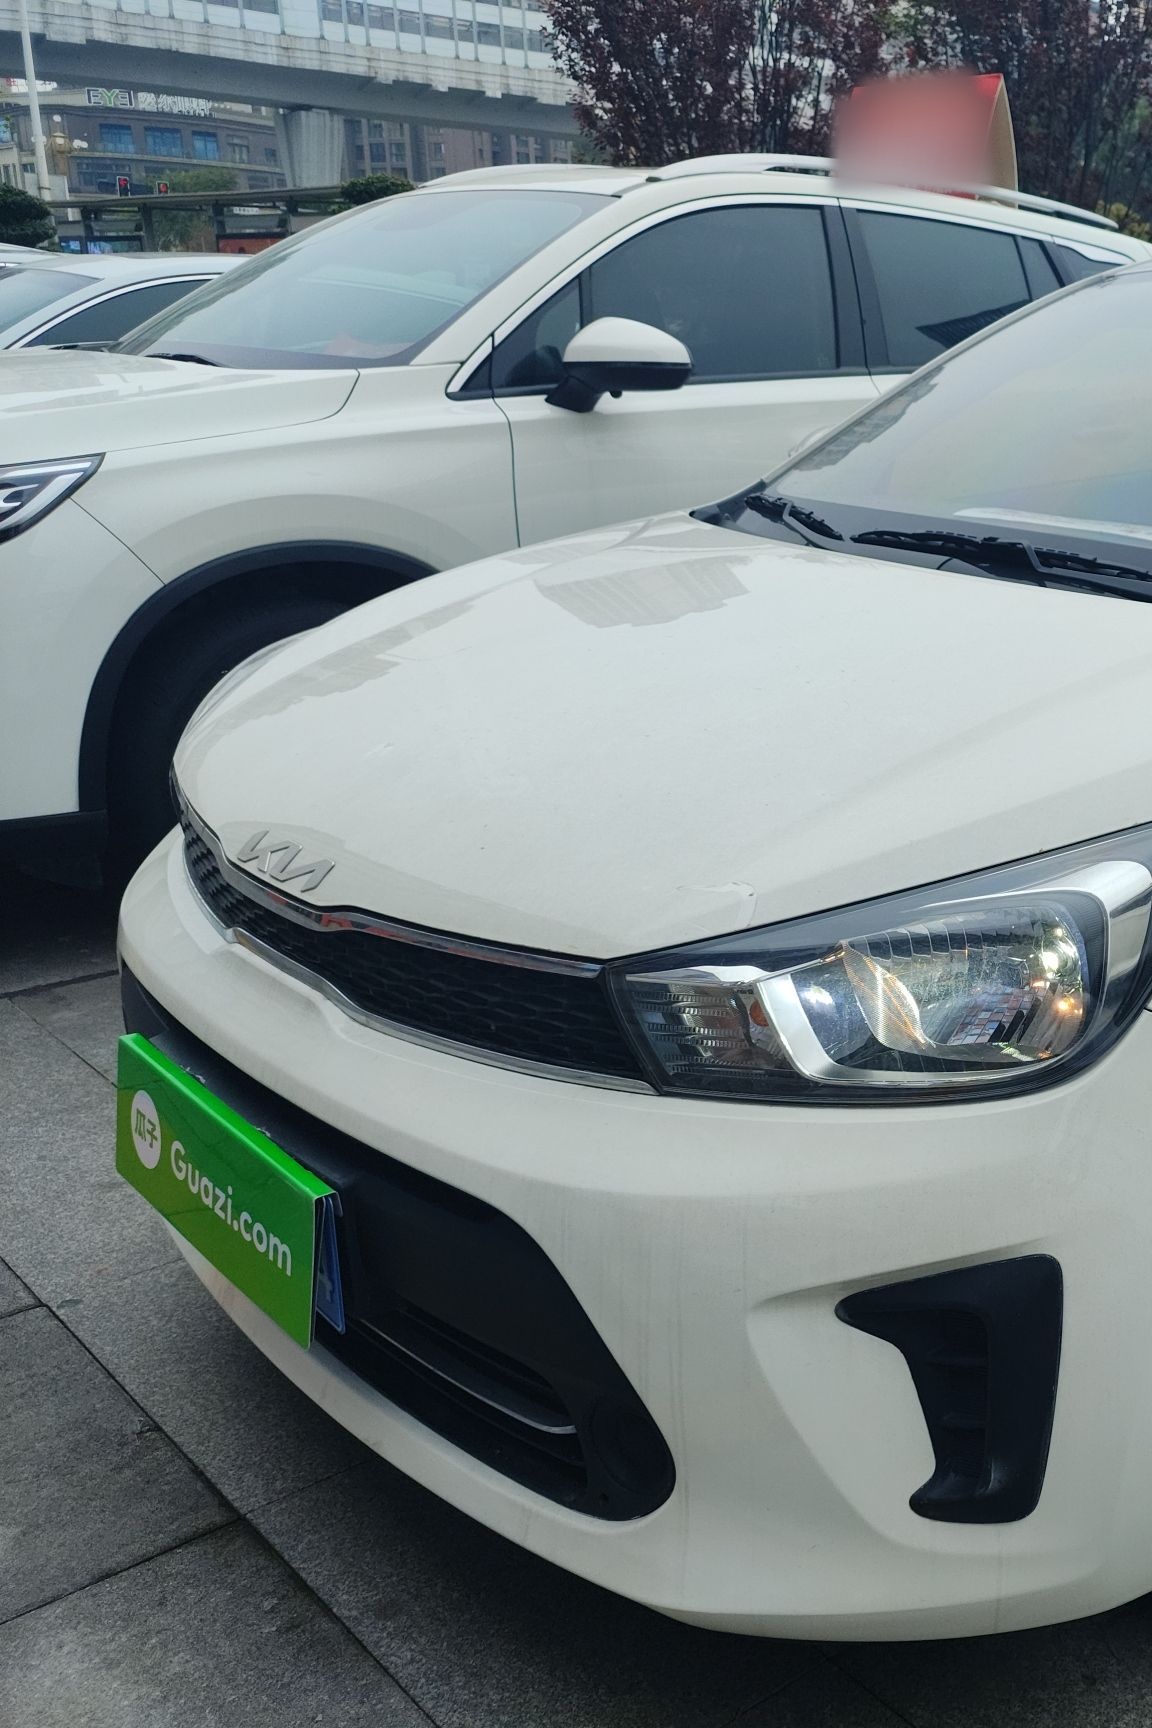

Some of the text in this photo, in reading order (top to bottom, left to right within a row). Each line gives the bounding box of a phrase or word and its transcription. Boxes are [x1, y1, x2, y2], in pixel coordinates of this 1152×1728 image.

[237, 828, 336, 893] KIA
[134, 1107, 159, 1150] 瓜子
[170, 1139, 293, 1278] Guazi.com
